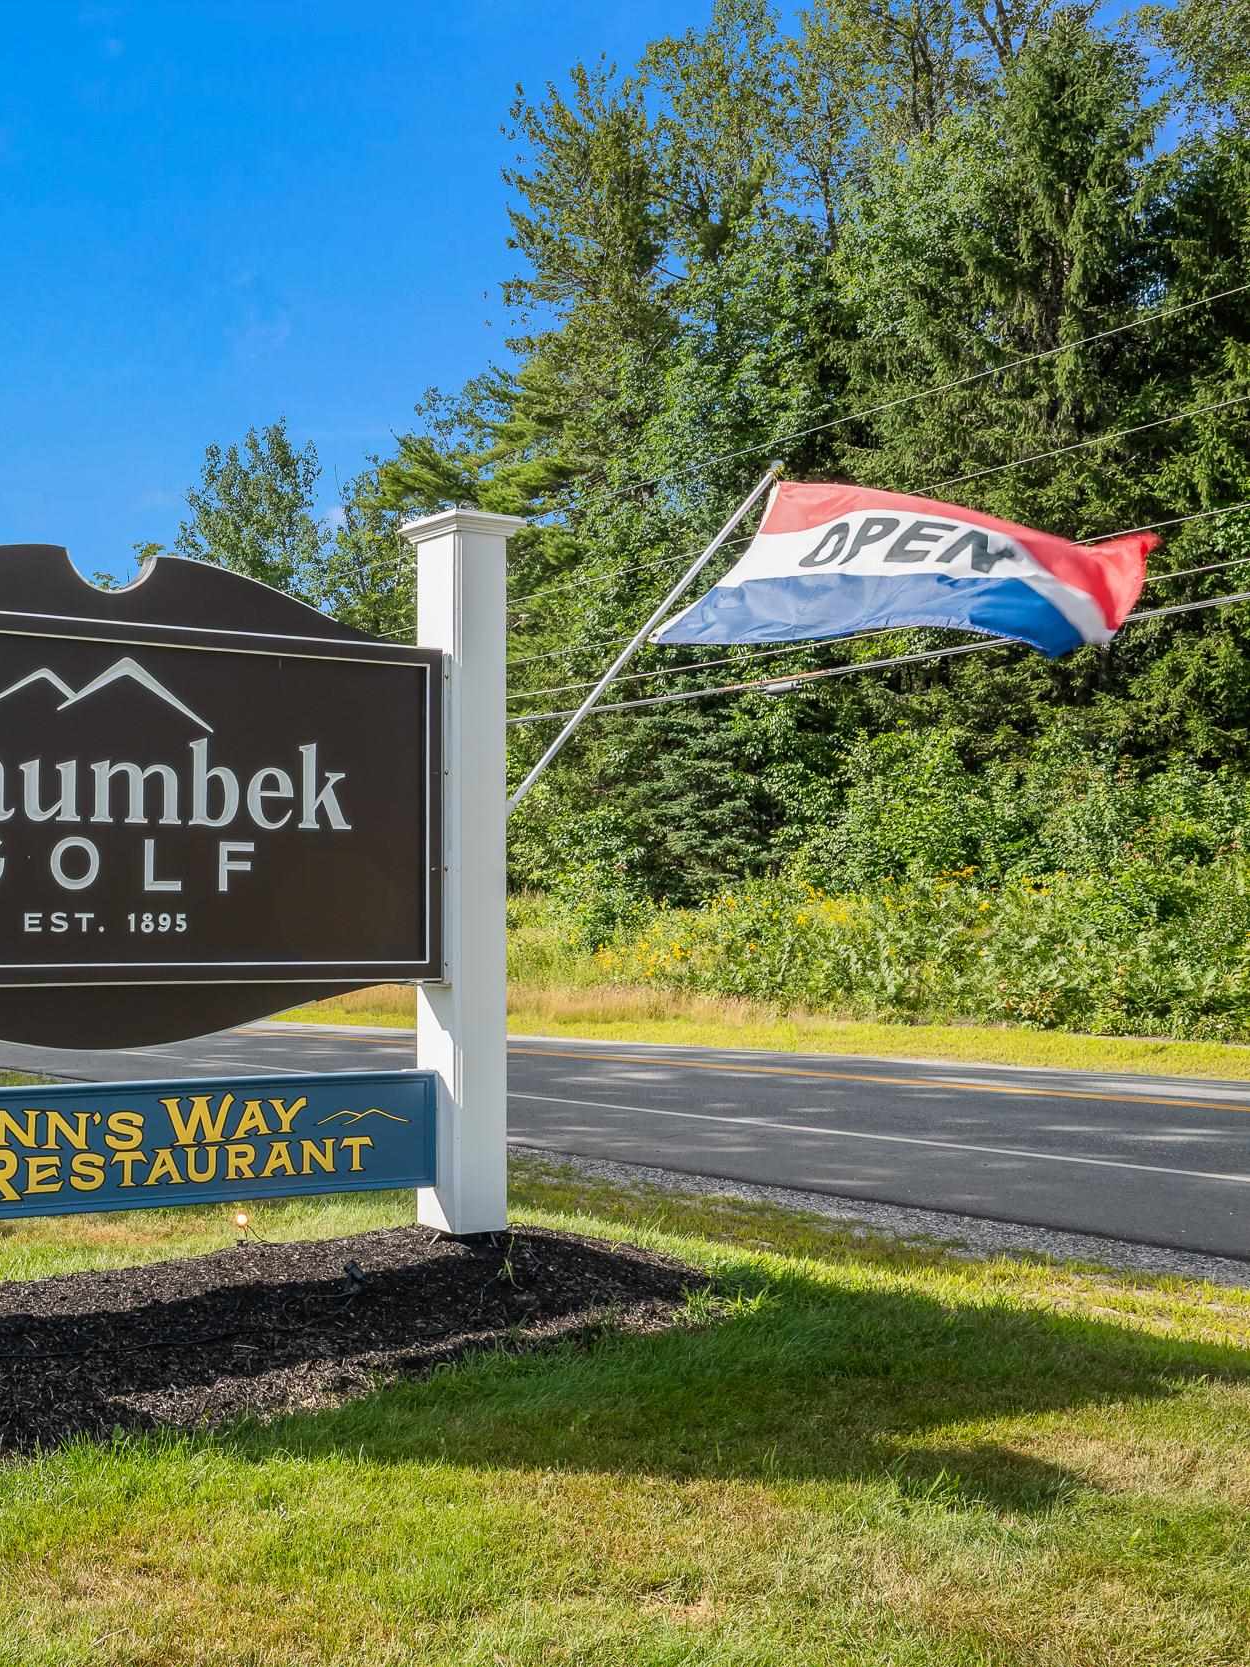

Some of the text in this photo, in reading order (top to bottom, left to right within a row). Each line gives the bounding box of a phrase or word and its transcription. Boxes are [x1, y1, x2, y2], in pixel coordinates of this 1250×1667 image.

[799, 517, 1017, 574] OPEN
[23, 911, 188, 933] EST. 1895
[158, 1091, 310, 1147] WAY
